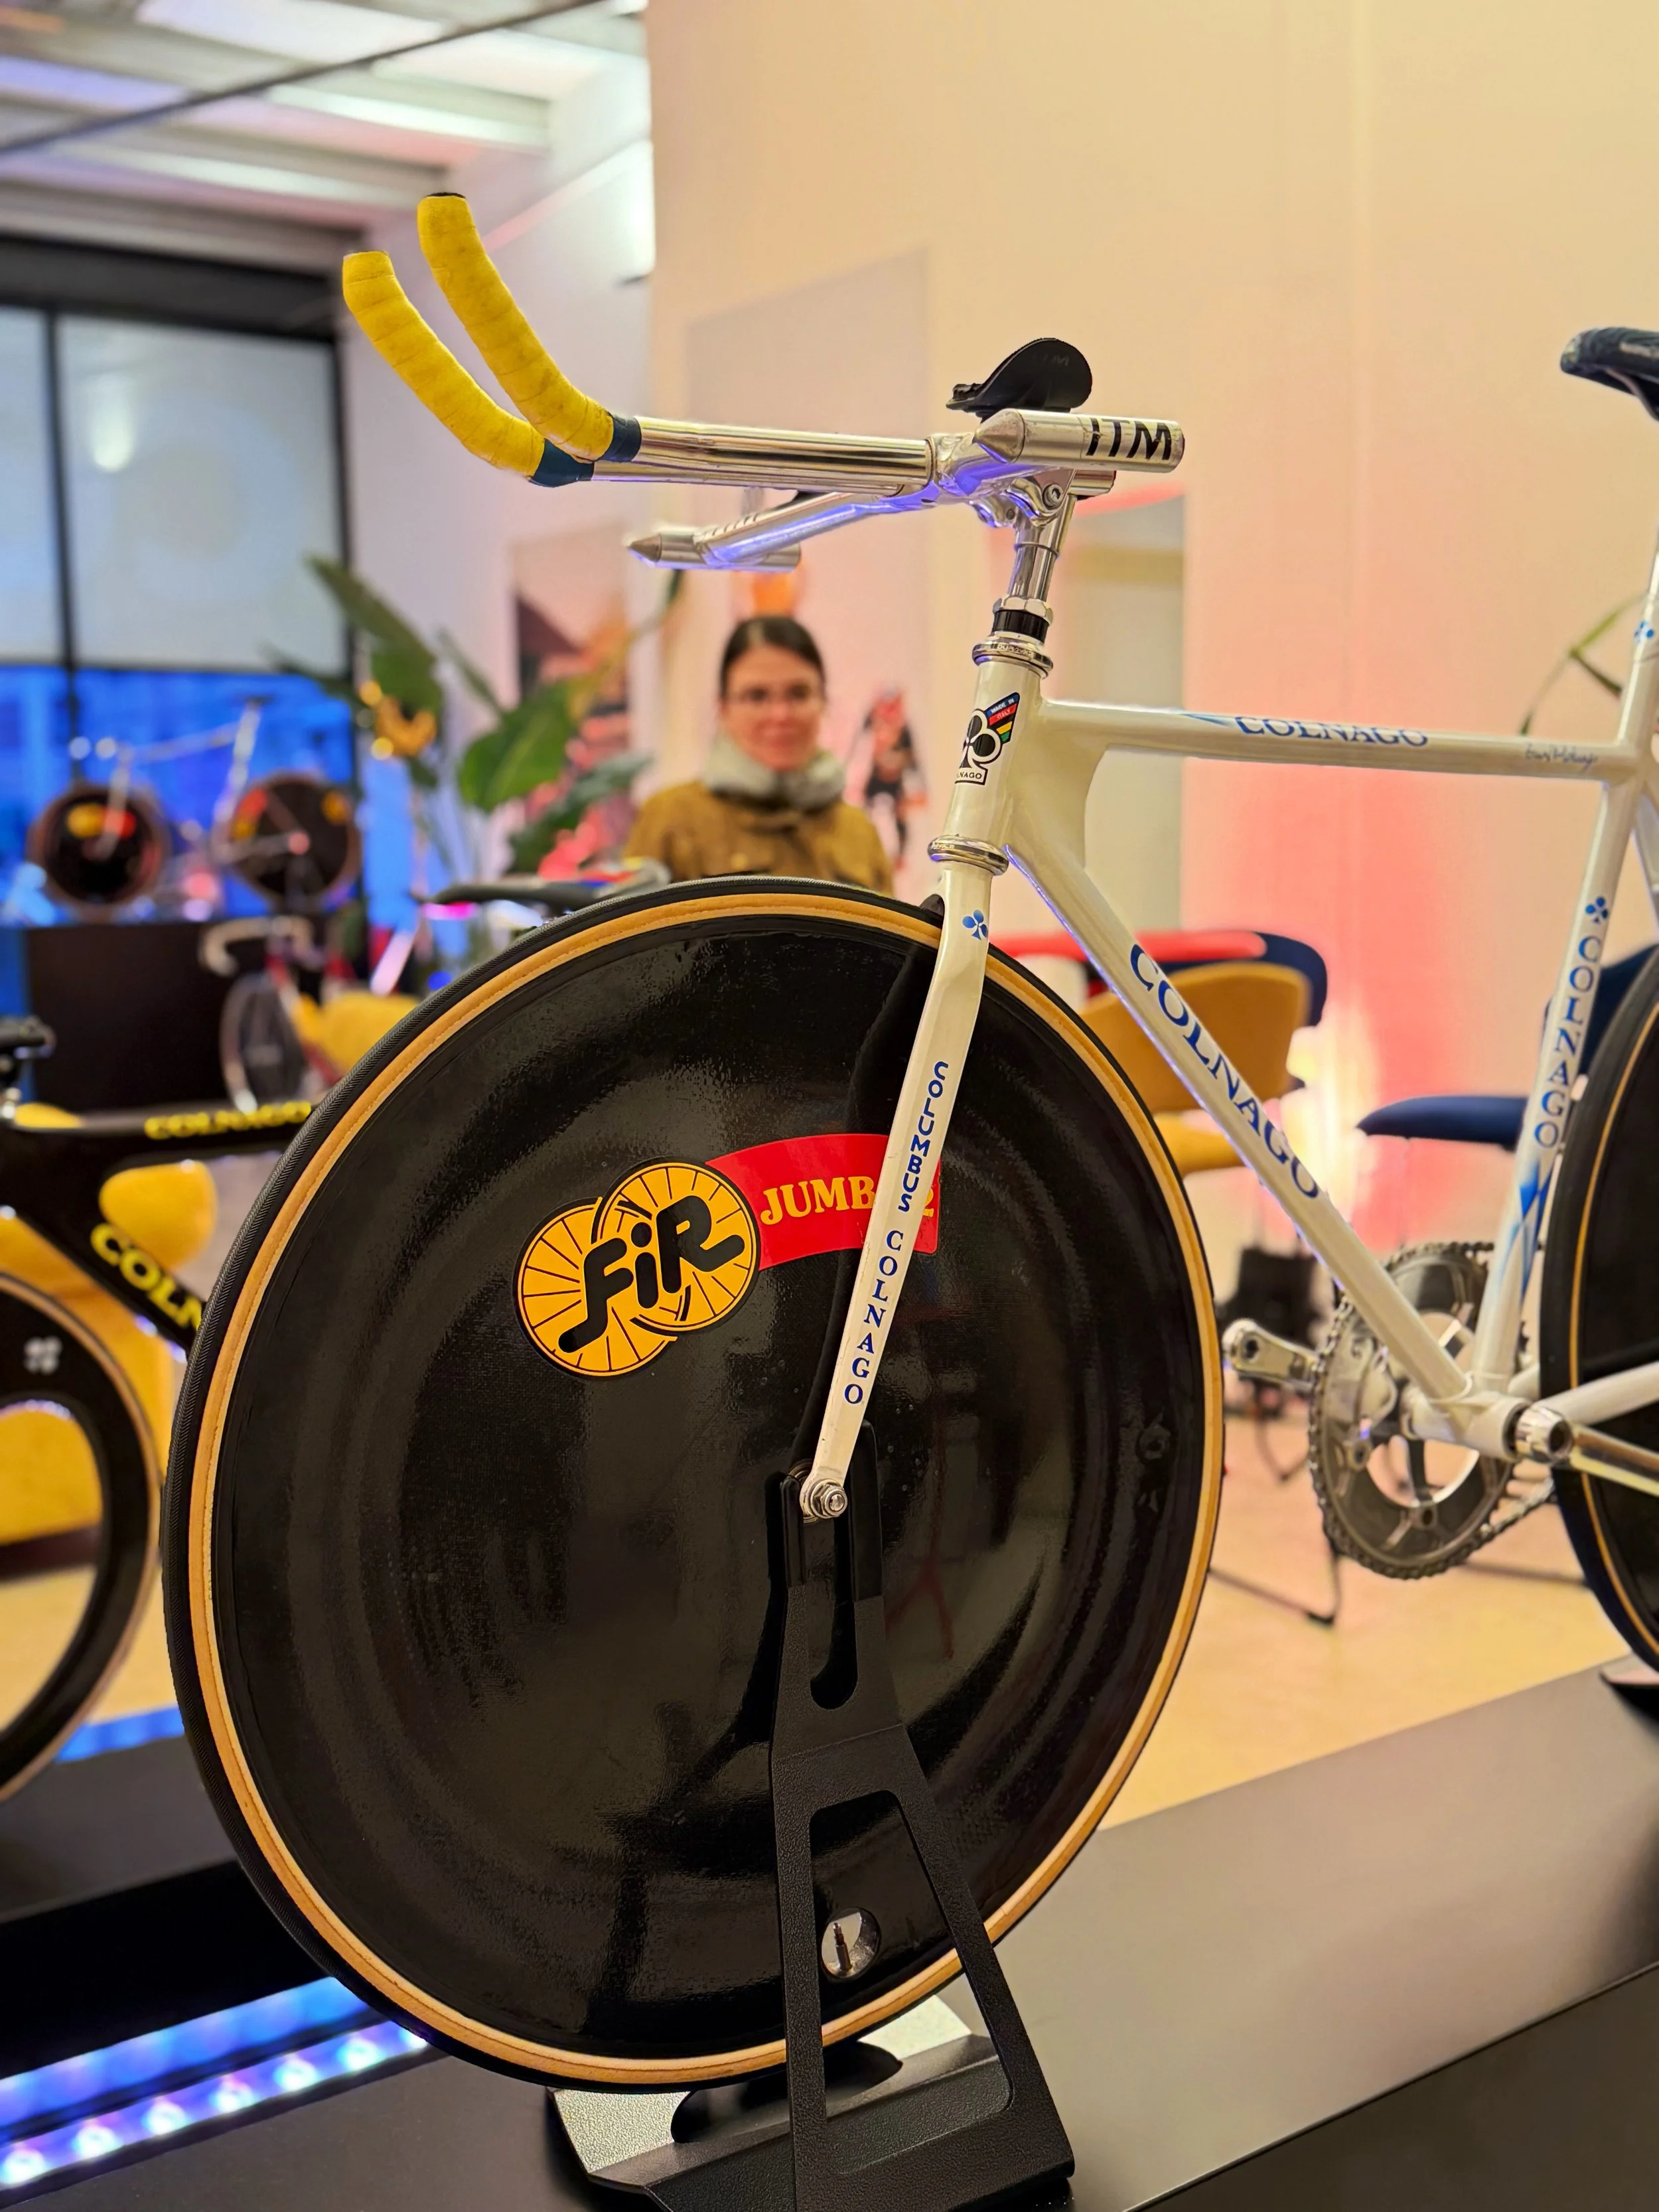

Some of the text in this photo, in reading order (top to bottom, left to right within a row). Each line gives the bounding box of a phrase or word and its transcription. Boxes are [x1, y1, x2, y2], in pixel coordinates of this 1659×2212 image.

[1086, 417, 1172, 461] ITM
[991, 701, 1007, 713] MADE
[997, 708, 1011, 720] ITALY
[1234, 716, 1428, 747] COLNAGO
[957, 771, 982, 780] NAGO
[1534, 935, 1602, 1149] COLNAGO
[1130, 943, 1319, 1199] COLNAGO
[844, 1061, 949, 1404] COLUMBUS COLNAGO
